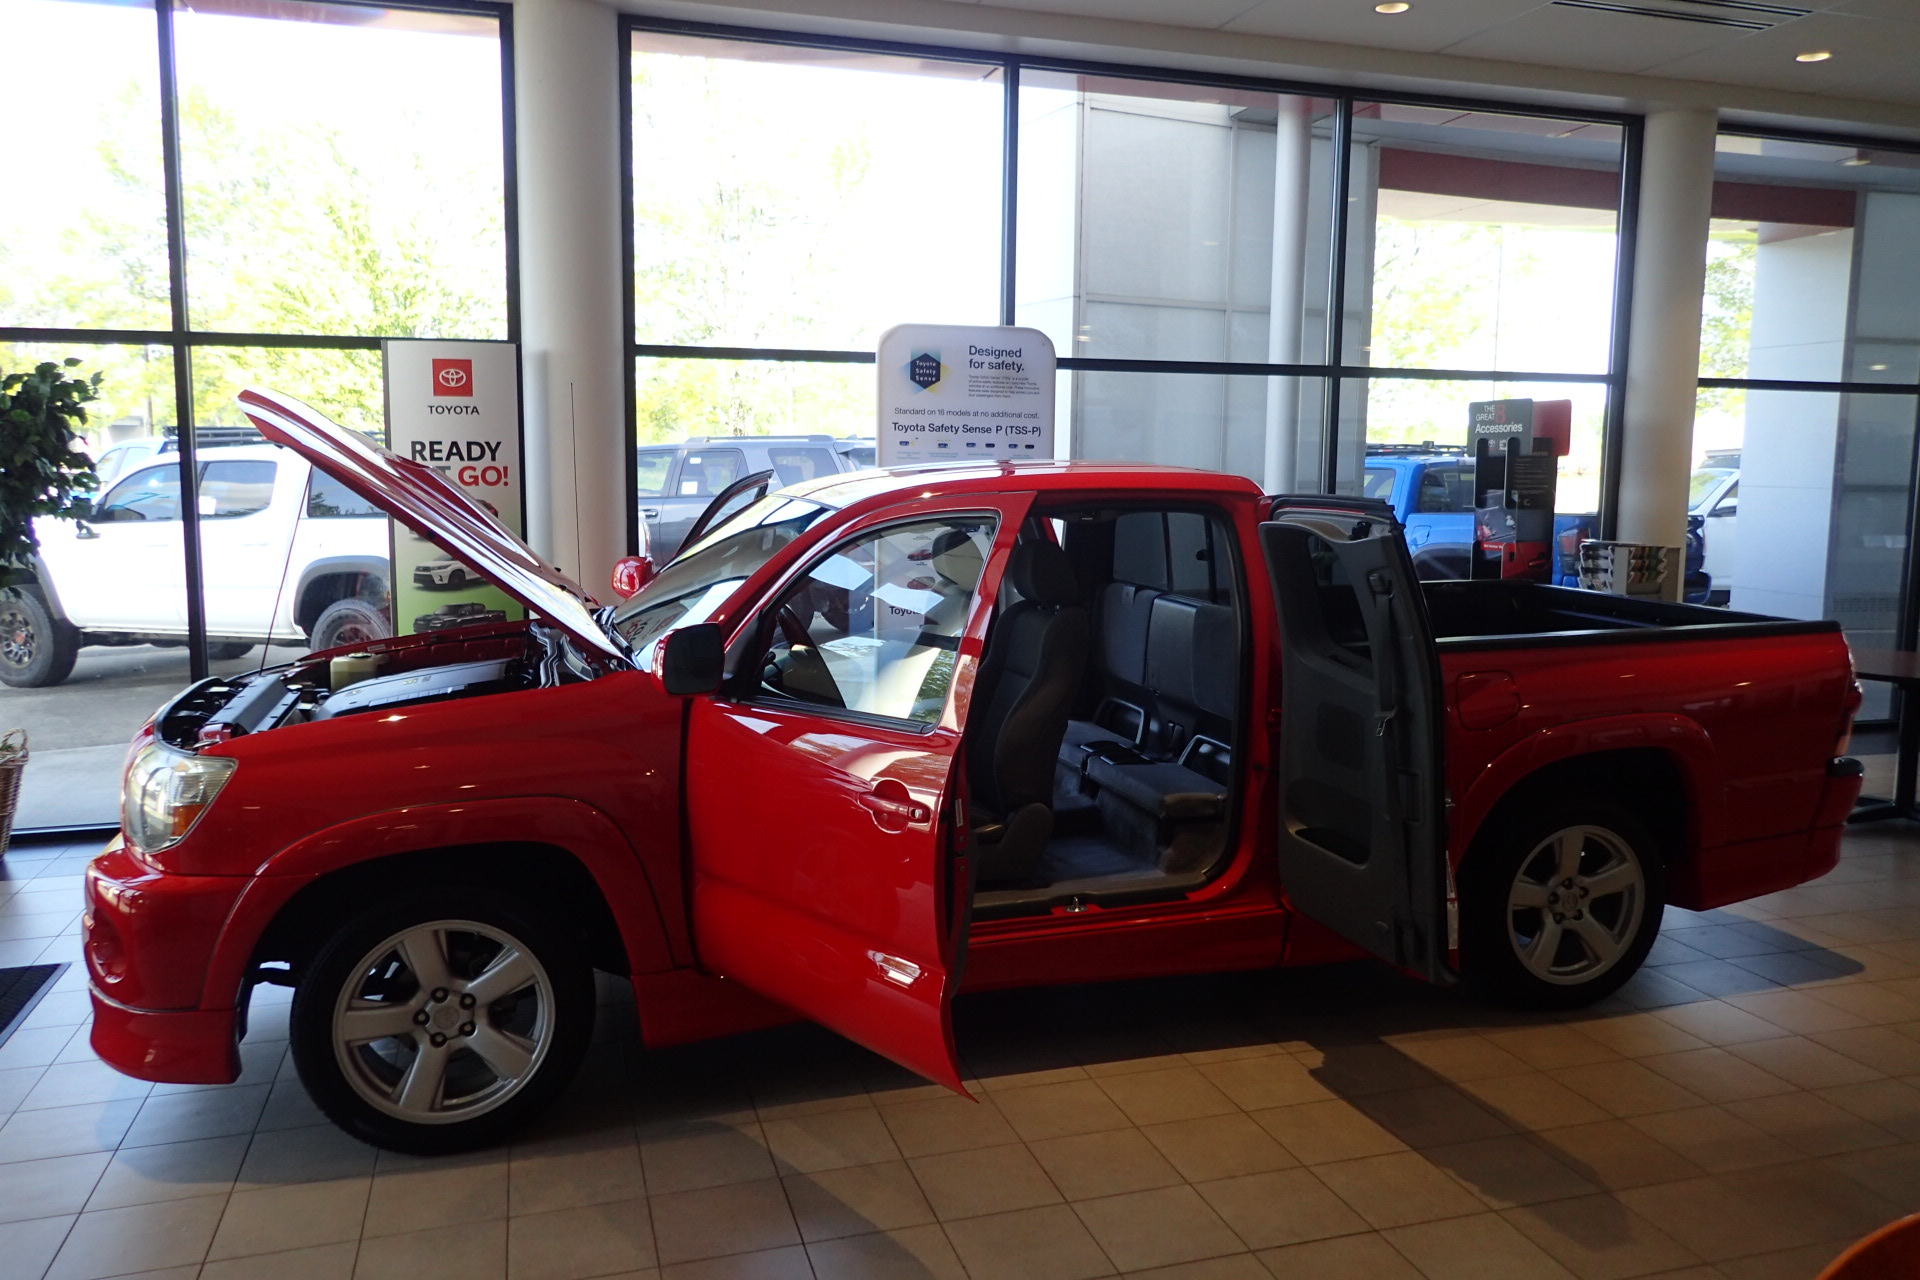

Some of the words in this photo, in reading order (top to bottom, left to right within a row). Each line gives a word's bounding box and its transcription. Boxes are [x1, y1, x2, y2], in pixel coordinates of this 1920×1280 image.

[969, 345, 1022, 360] Designed
[969, 358, 985, 369] for
[987, 360, 1025, 373] safety.
[427, 405, 480, 415] TOYOTA
[894, 407, 926, 415] Standard
[946, 409, 971, 417] models
[990, 411, 1023, 419] additional
[1484, 404, 1495, 412] THE
[1475, 412, 1495, 421] GREAT
[892, 422, 925, 433] Toyota
[928, 422, 960, 435] Safety
[962, 424, 992, 433] Sense
[995, 425, 1003, 434] P
[1004, 425, 1042, 437] (TSS-P)
[1475, 421, 1522, 433] Accessories
[411, 441, 501, 461] READY
[458, 466, 508, 486] GO!
[889, 605, 921, 617] Toyo
